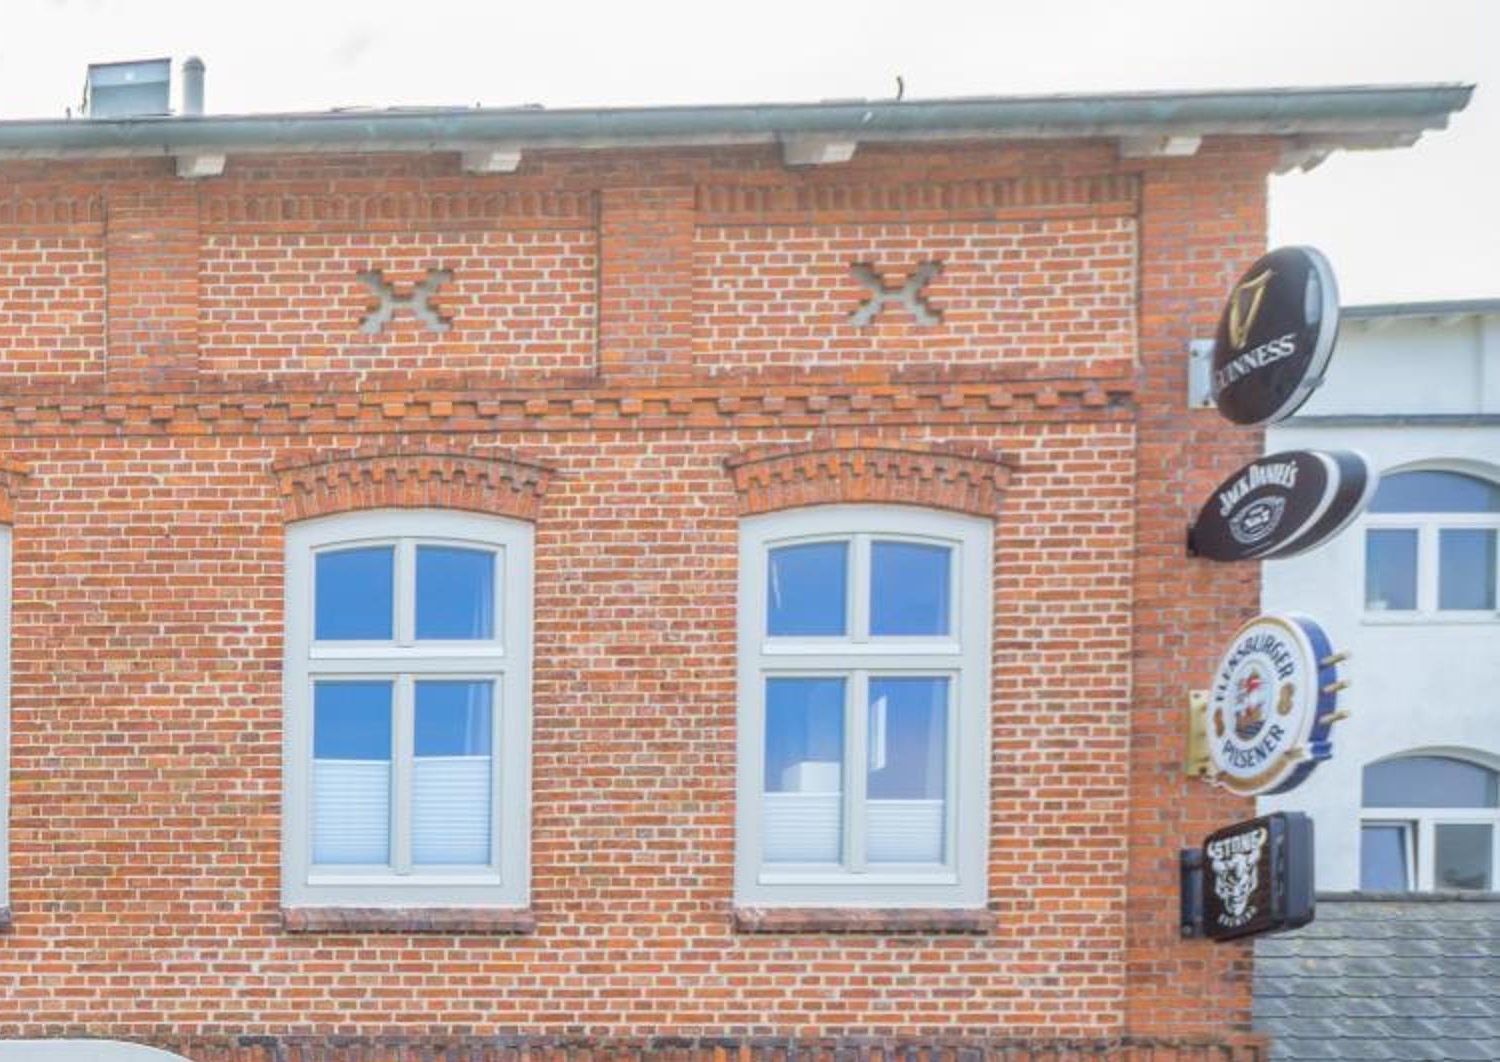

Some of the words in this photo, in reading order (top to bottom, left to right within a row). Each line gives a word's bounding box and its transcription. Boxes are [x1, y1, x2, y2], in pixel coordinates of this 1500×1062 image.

[1219, 476, 1249, 517] JACK
[1216, 633, 1295, 702] FLENSBURGER
[1222, 724, 1285, 769] PILSENER
